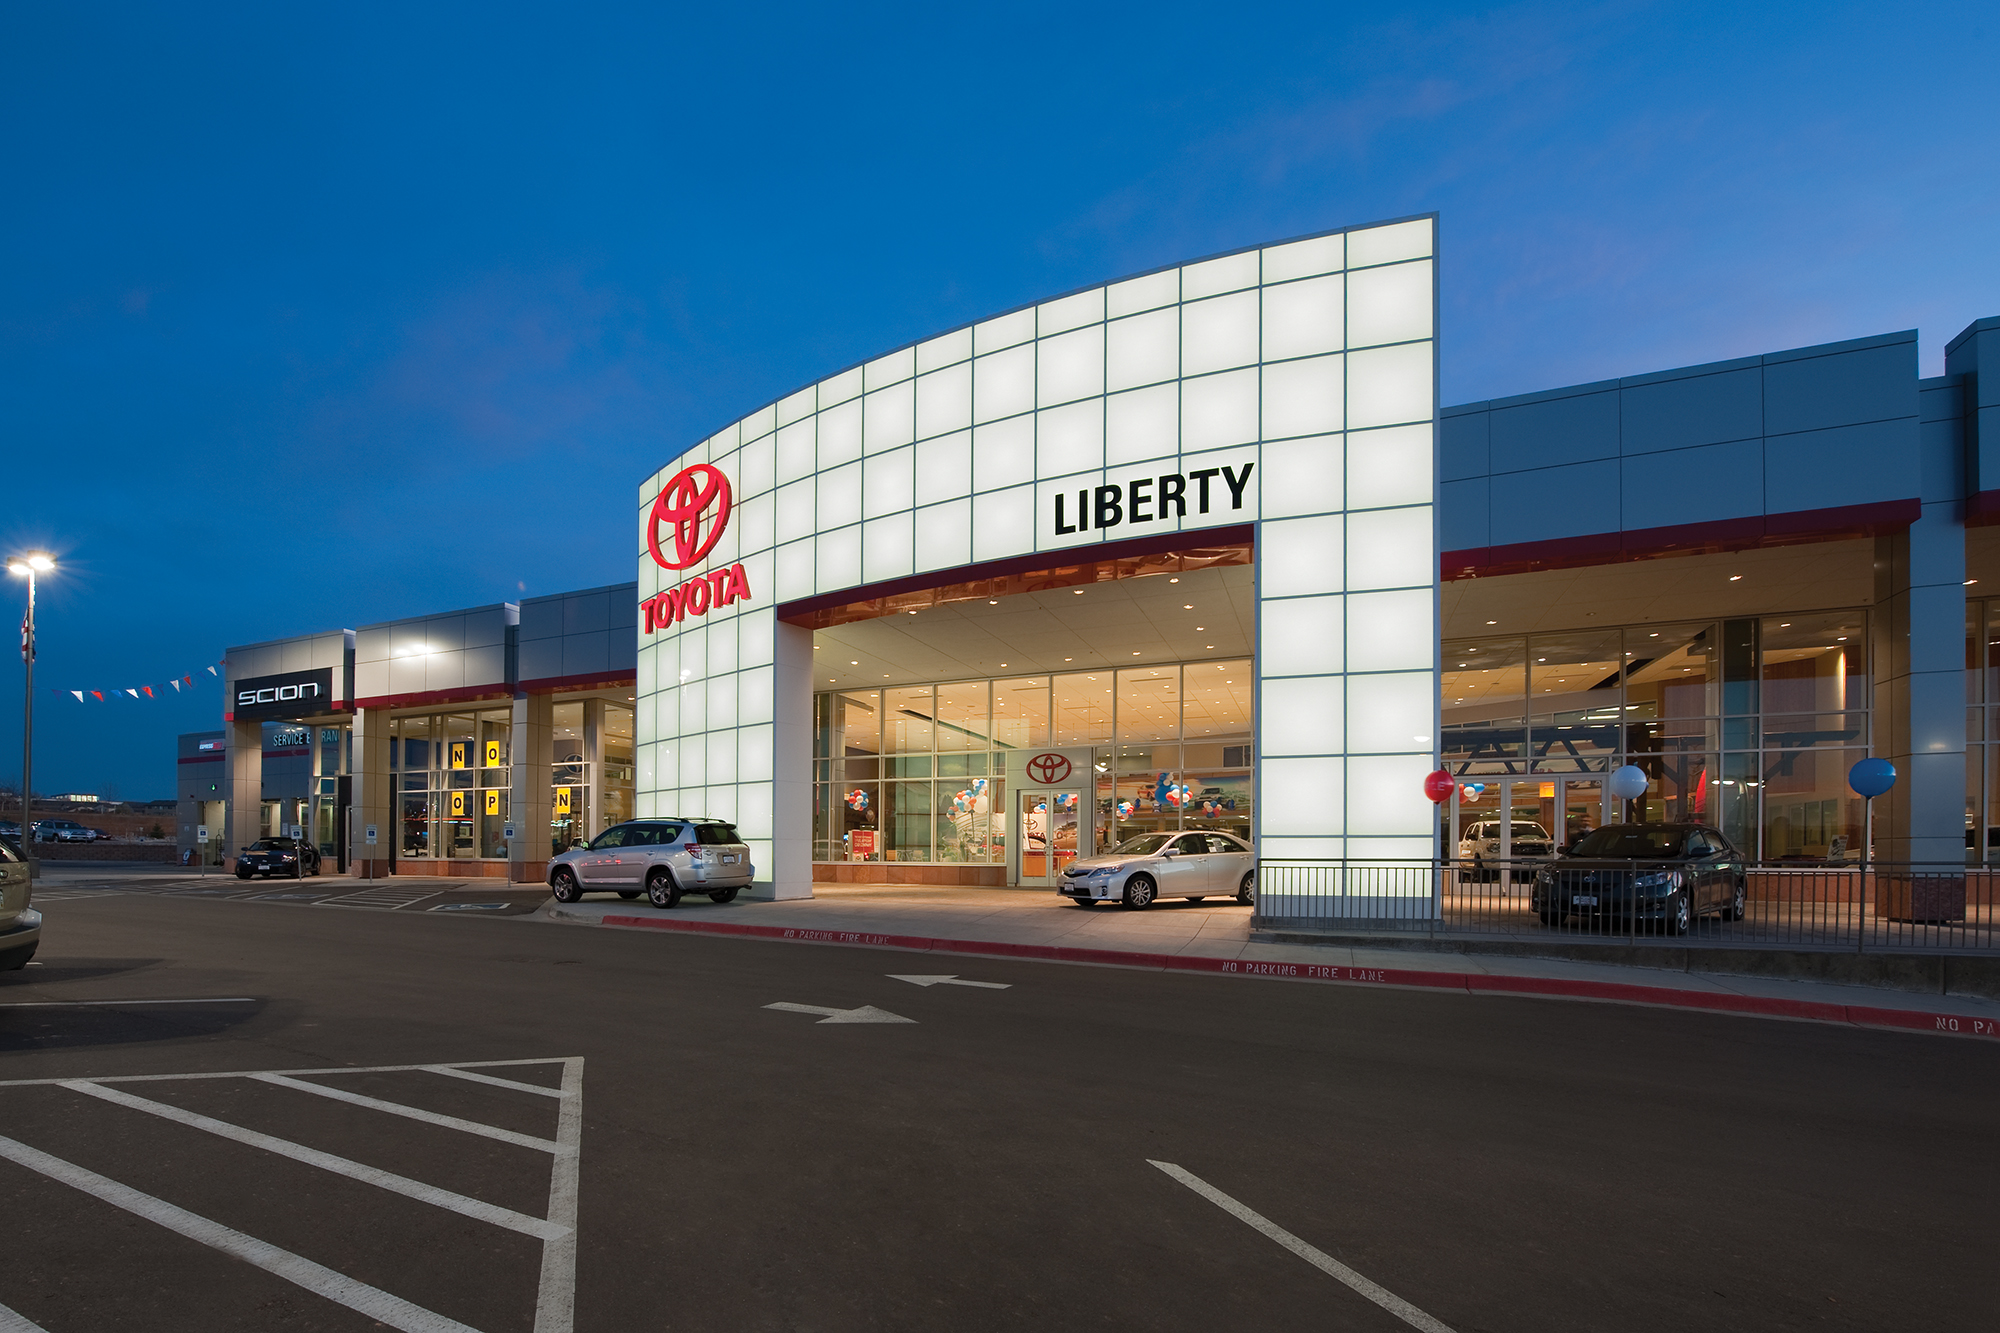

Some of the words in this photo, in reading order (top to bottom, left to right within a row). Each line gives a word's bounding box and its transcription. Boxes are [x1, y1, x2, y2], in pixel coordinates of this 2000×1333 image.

[1055, 462, 1255, 536] LIBERTY
[641, 563, 752, 635] TOYOTA
[273, 733, 304, 747] SERVICE
[783, 929, 795, 938] NO
[799, 930, 833, 941] PARKING
[840, 933, 860, 943] FIRE
[866, 935, 889, 945] LANE
[1222, 961, 1237, 973] NO
[1246, 963, 1297, 976] PARKING
[1308, 966, 1339, 978] FIRE
[1350, 969, 1385, 982] LANE
[1936, 1016, 1959, 1031] NO
